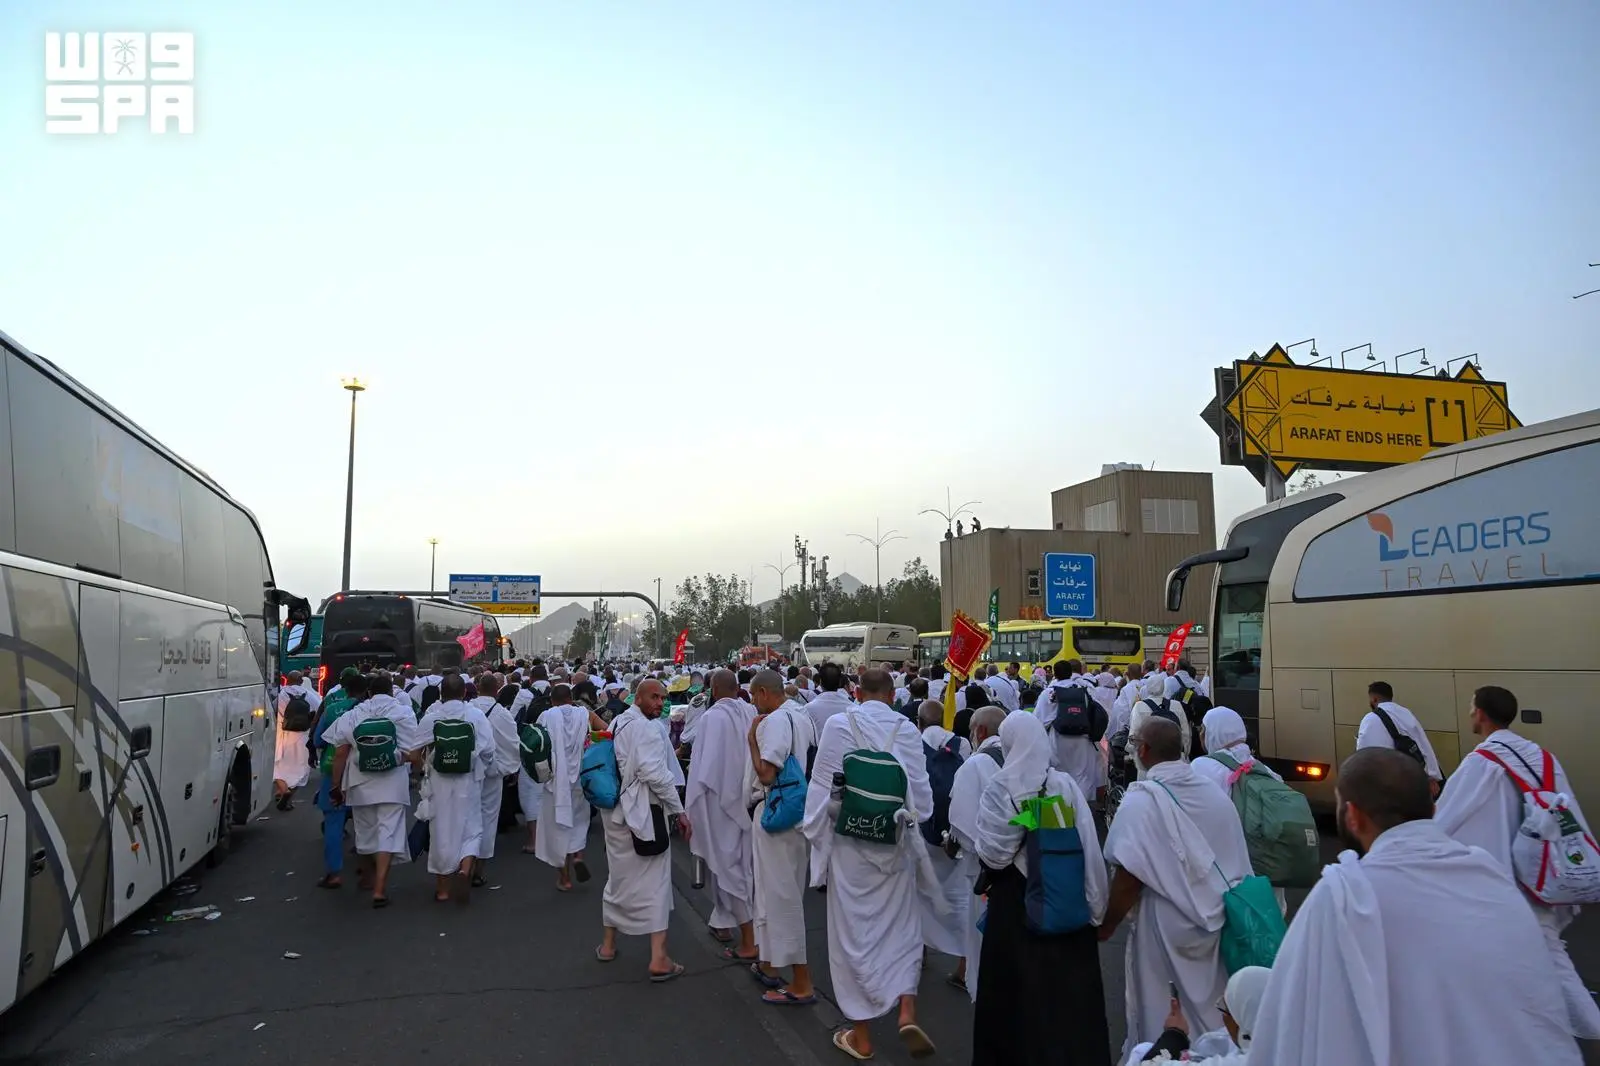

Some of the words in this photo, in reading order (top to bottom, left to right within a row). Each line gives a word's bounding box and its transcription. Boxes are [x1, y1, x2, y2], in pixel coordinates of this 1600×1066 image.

[1290, 388, 1357, 411] عرفات
[1364, 394, 1416, 416] نهاية
[1289, 425, 1341, 443] ARAFAT
[1345, 431, 1383, 445] ENDS
[1387, 433, 1423, 447] HERE
[1367, 511, 1551, 562] LEADERS
[1059, 560, 1082, 572] نهاية
[1378, 553, 1560, 591] TRAVEL
[1053, 576, 1088, 589] عرفات
[1055, 592, 1086, 600] ARAFAT
[1063, 603, 1079, 611] END
[844, 824, 886, 839] PAKISTAN
